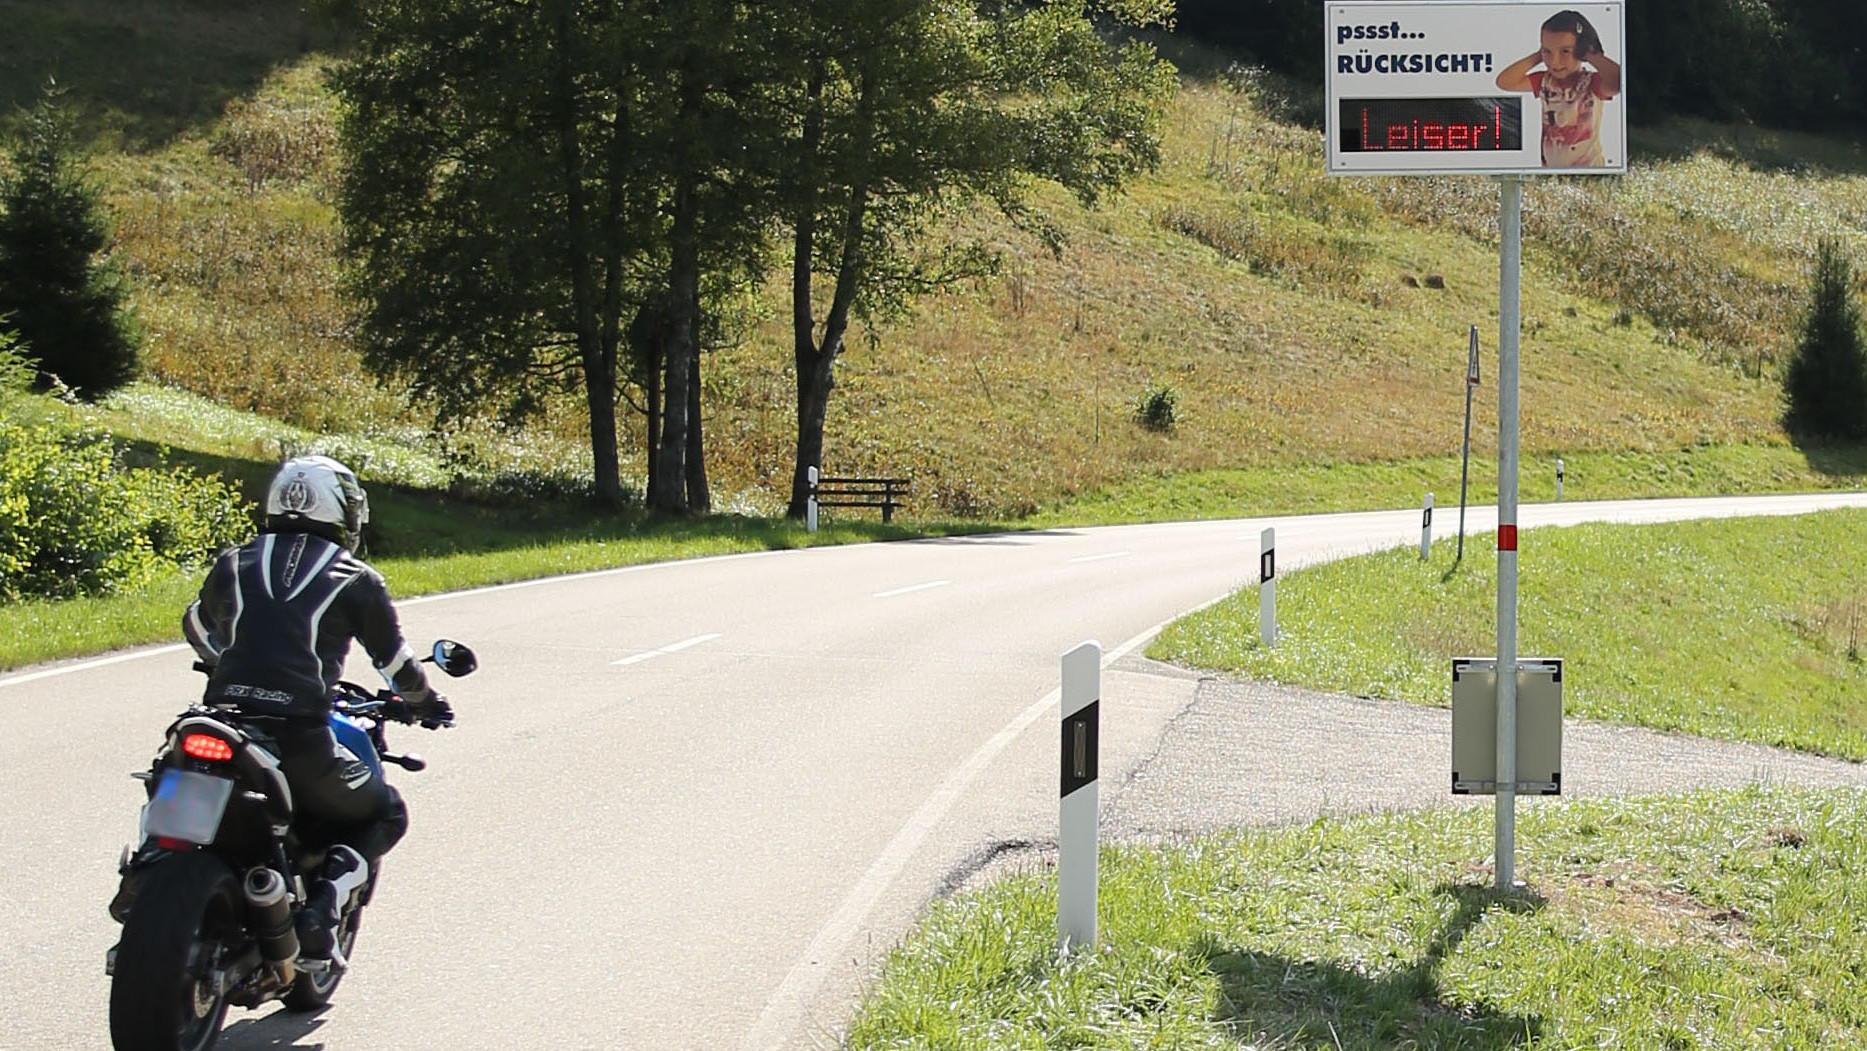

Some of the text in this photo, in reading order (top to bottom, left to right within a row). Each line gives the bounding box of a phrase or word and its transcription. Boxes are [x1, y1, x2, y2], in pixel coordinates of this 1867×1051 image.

[1337, 21, 1426, 44] pssst...
[1337, 49, 1493, 74] RÜCKSICHT!
[1362, 104, 1501, 150] Leiser!
